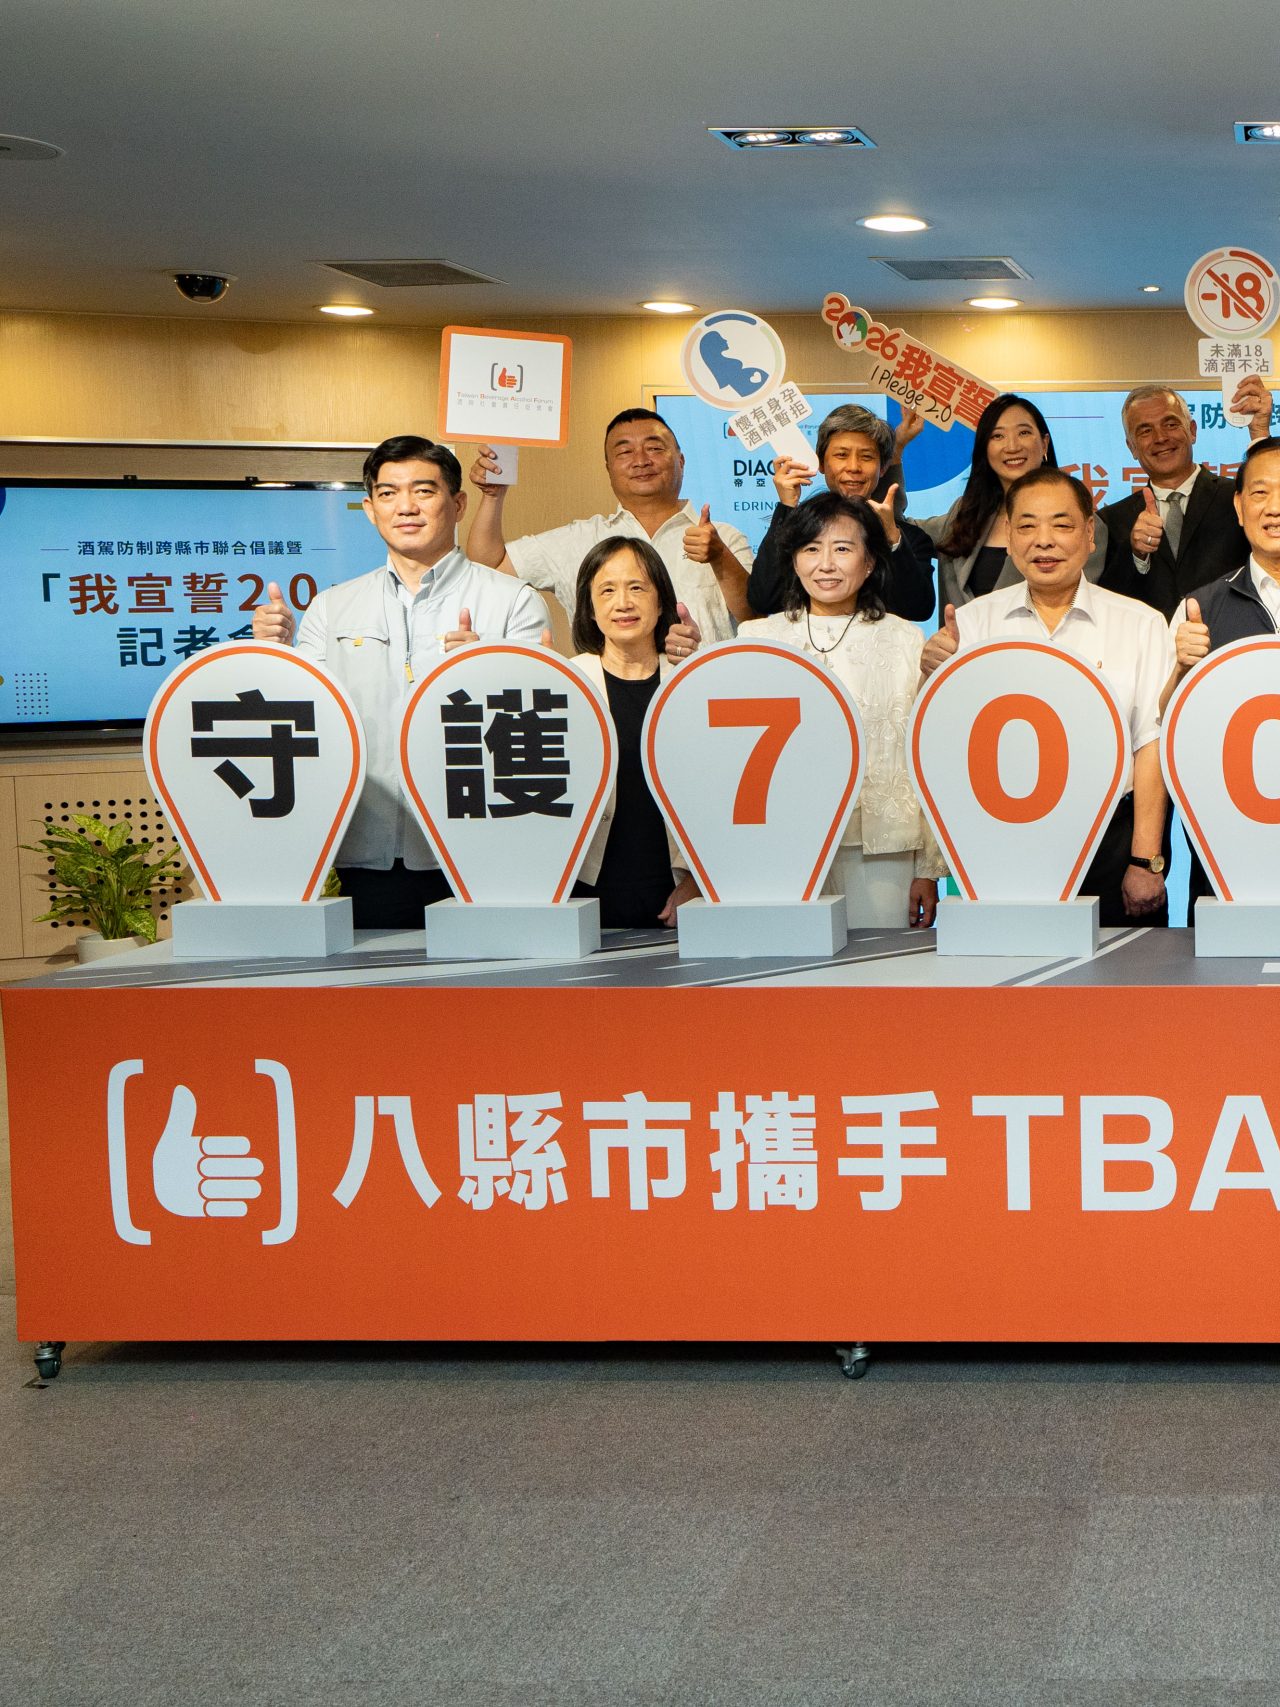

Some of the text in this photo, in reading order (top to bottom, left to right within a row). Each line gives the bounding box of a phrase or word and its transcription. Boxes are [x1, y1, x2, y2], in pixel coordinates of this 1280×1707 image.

[1204, 358, 1270, 373] 滴酒不沾
[1210, 343, 1263, 358] 未滿18
[735, 387, 798, 433] 懷有身孕
[878, 369, 925, 406] Pledge
[924, 395, 952, 423] 2.0
[743, 400, 808, 447] 酒精暫拒
[734, 501, 779, 511] EDRIN
[77, 540, 303, 555] 酒駕防制跨縣市聯合倡議暨
[116, 623, 254, 667] 記者
[190, 688, 320, 819] 守
[440, 688, 575, 820] 護
[708, 697, 802, 825] 7
[967, 693, 1070, 824] 0
[331, 1090, 948, 1212] 八縣市攜手
